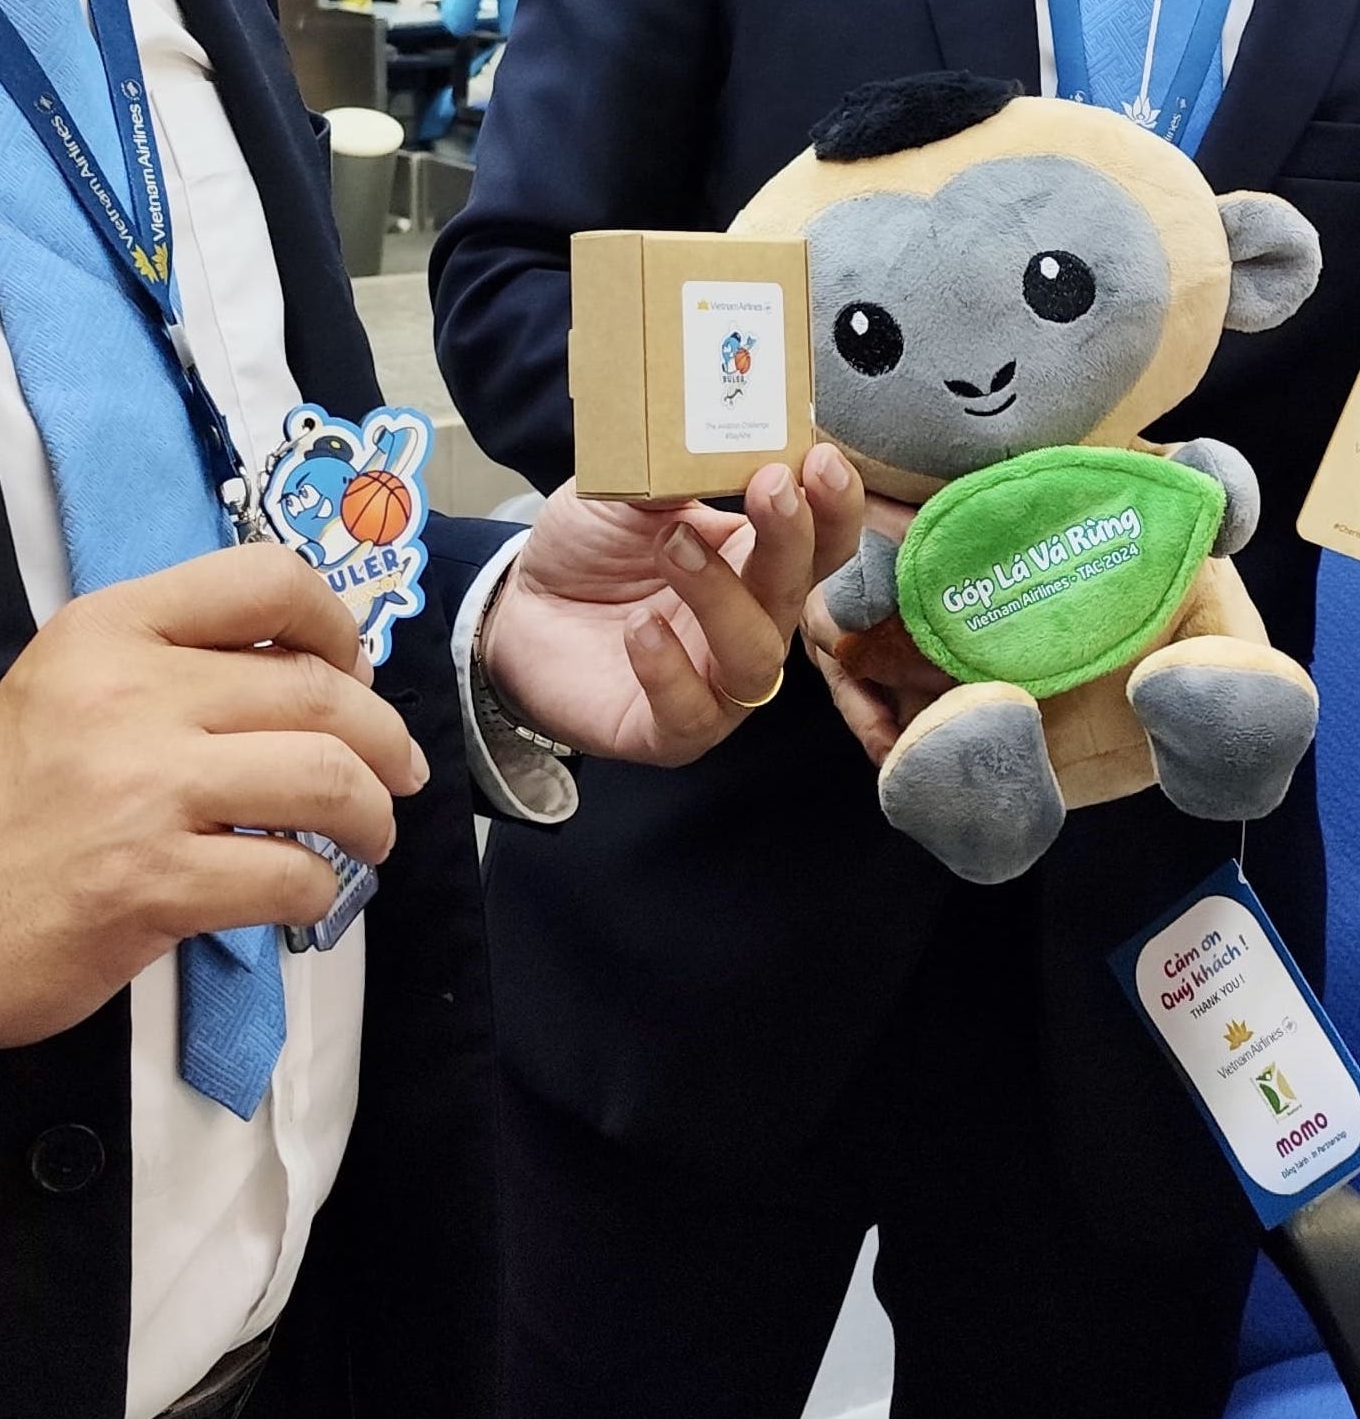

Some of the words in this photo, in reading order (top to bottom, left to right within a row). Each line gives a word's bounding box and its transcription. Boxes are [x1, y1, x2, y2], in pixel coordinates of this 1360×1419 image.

[327, 547, 401, 593] ULER
[943, 578, 995, 613] Góp
[993, 553, 1031, 590] Lá
[1027, 535, 1069, 571] Vá
[1065, 506, 1142, 555] Rừng
[966, 599, 1020, 632] Vietnam
[1021, 575, 1071, 607] Airlines
[1076, 560, 1104, 580] TAC
[1103, 542, 1140, 570] 2024
[1161, 977, 1195, 1011] Quý
[1191, 944, 1242, 988] khách
[1164, 947, 1201, 979] Cảm
[1190, 992, 1222, 1019] THANK
[1219, 977, 1240, 998] YOU
